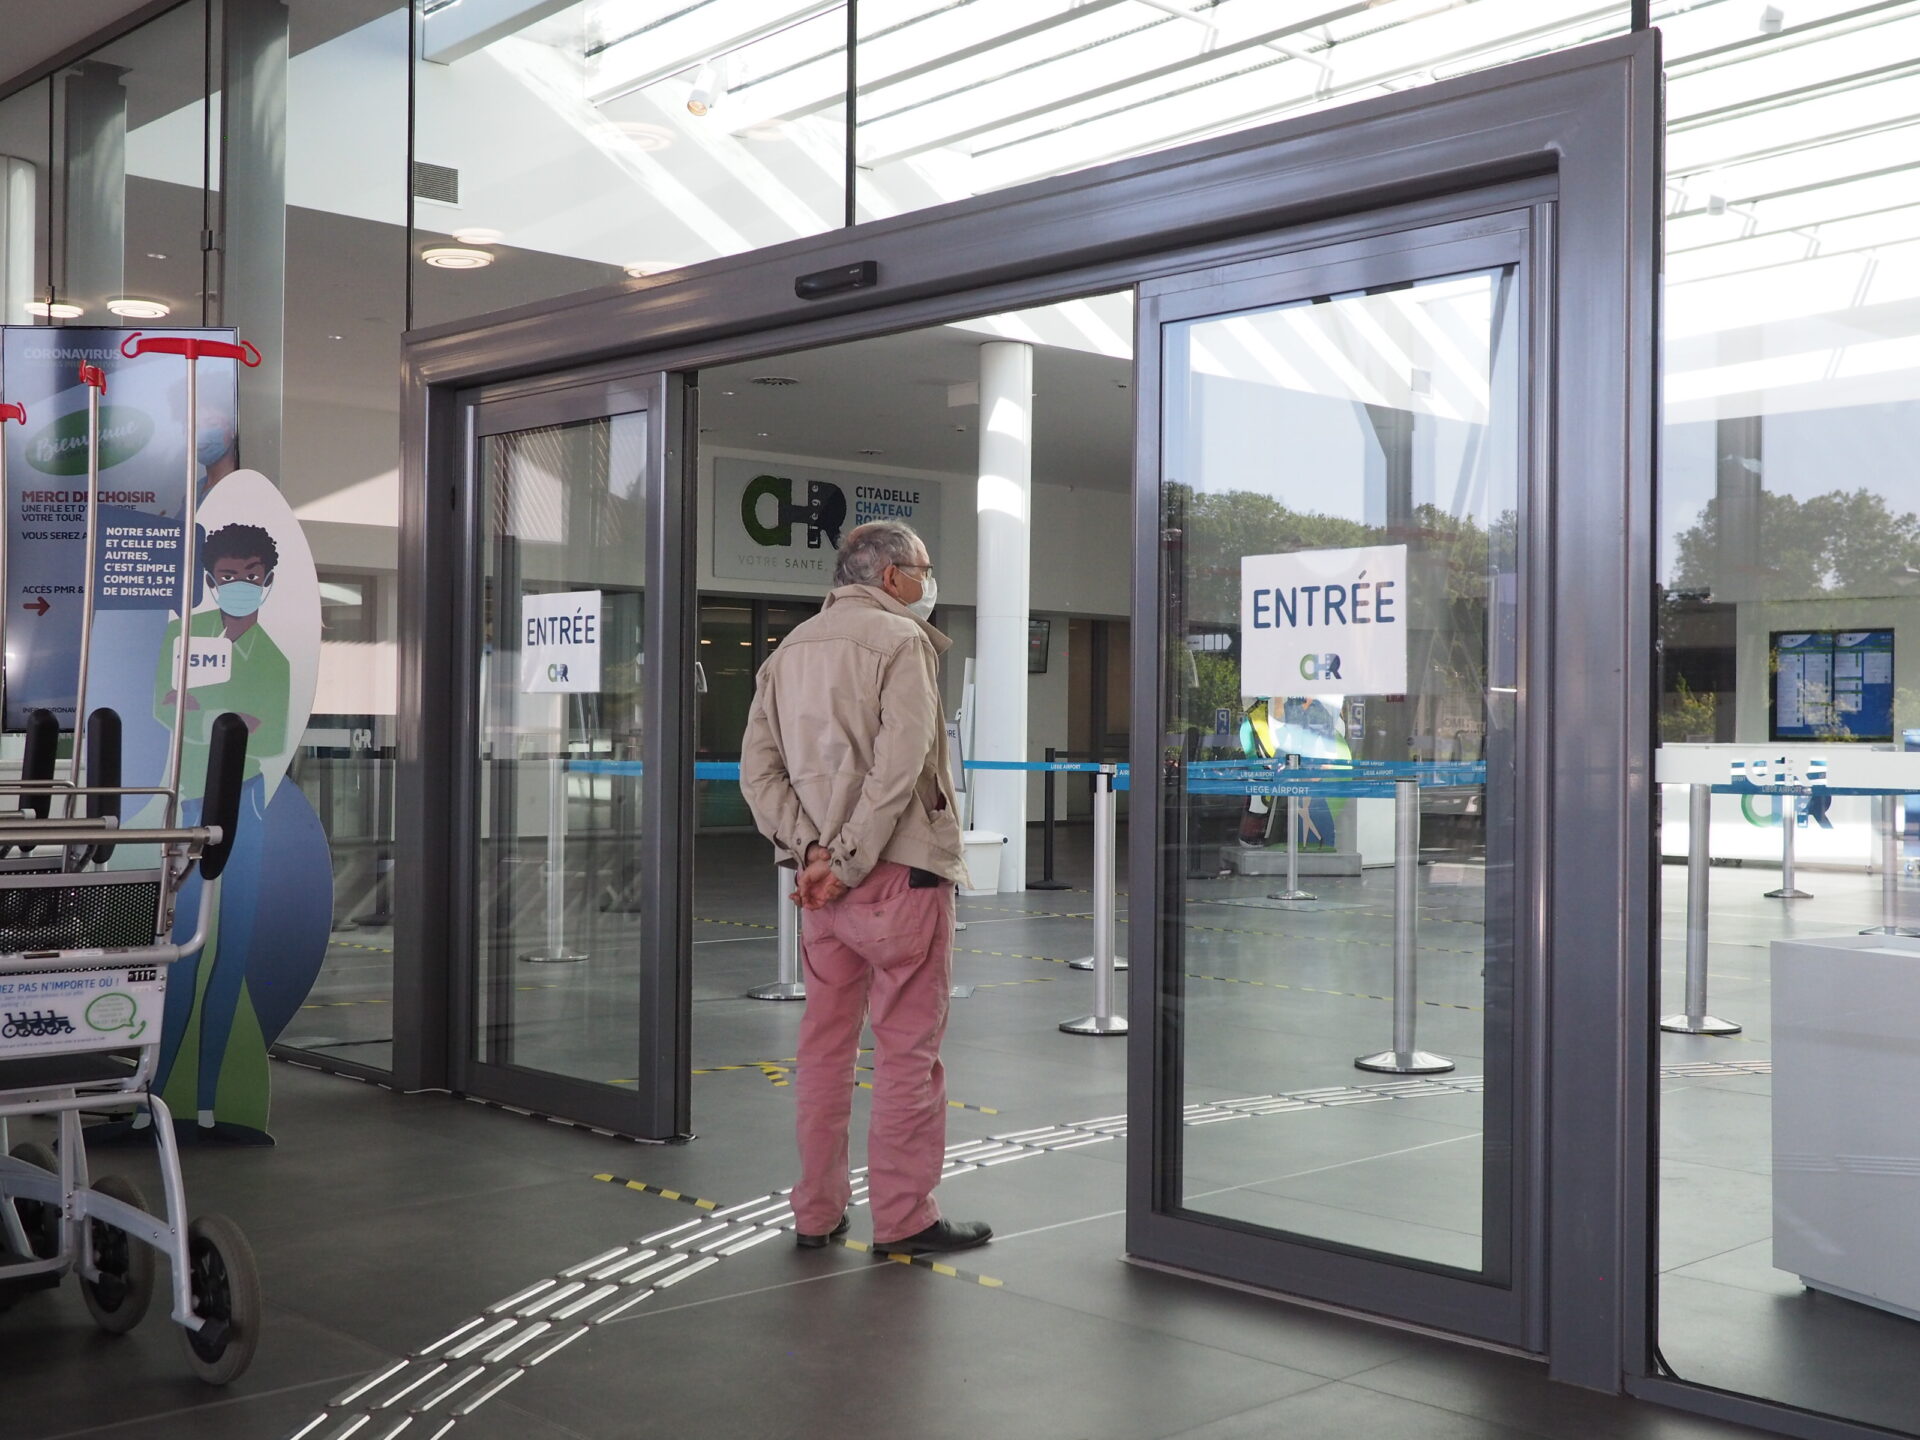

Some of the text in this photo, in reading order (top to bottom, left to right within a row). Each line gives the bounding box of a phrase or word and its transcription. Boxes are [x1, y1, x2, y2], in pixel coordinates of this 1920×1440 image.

[24, 347, 120, 360] CORONAVIRUS
[36, 421, 136, 462] Bienvnue
[22, 491, 68, 503] MERCI
[855, 486, 920, 504] CITADELLE
[22, 504, 41, 513] UNE
[44, 504, 62, 513] FILE
[64, 504, 76, 513] ET
[855, 501, 913, 518] CHATEAU
[22, 514, 85, 522] VOTRE TOUR.
[22, 531, 48, 540] VOUS
[50, 531, 79, 540] SEREZ
[106, 526, 181, 537] NOTRE SANTÉ
[105, 539, 177, 549] ET CELLE DES
[105, 551, 151, 562] AUTRES,
[136, 563, 176, 573] SIMPLE
[103, 575, 176, 586] COMME 1,5 M
[54, 585, 75, 594] PMR
[103, 586, 173, 597] DE DISTANCE
[1252, 570, 1396, 629] ENTRÉE
[527, 606, 595, 647] ENTRÉE
[1245, 784, 1309, 795] LIEGE AIRPORT
[18, 981, 38, 992] PAS
[41, 978, 96, 991] N'IMPORTE
